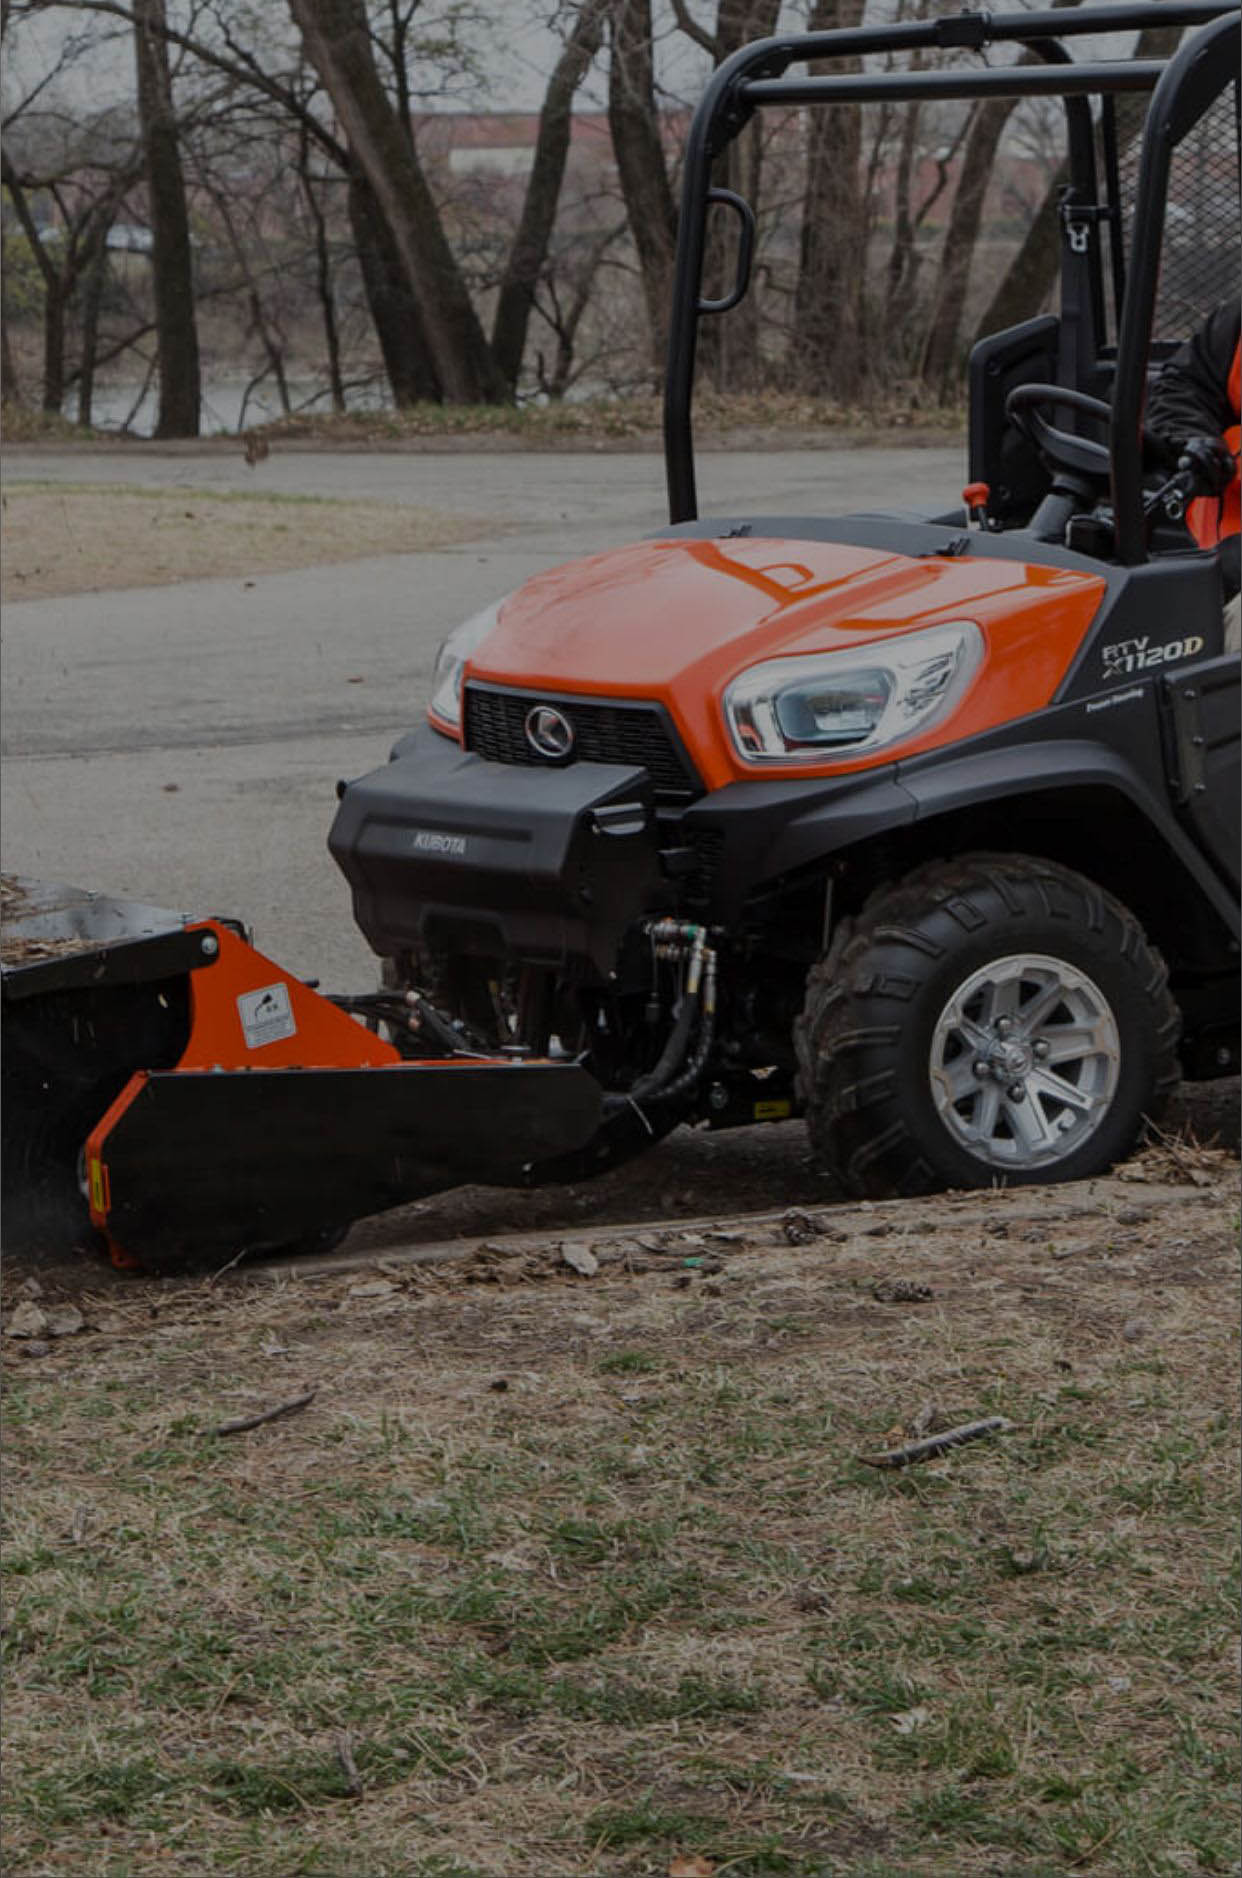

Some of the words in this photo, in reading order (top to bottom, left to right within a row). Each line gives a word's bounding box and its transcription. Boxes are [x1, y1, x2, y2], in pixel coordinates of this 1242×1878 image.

[1101, 636, 1204, 680] X1120D
[1102, 636, 1149, 660] RTV
[412, 831, 467, 855] KUBOTA
